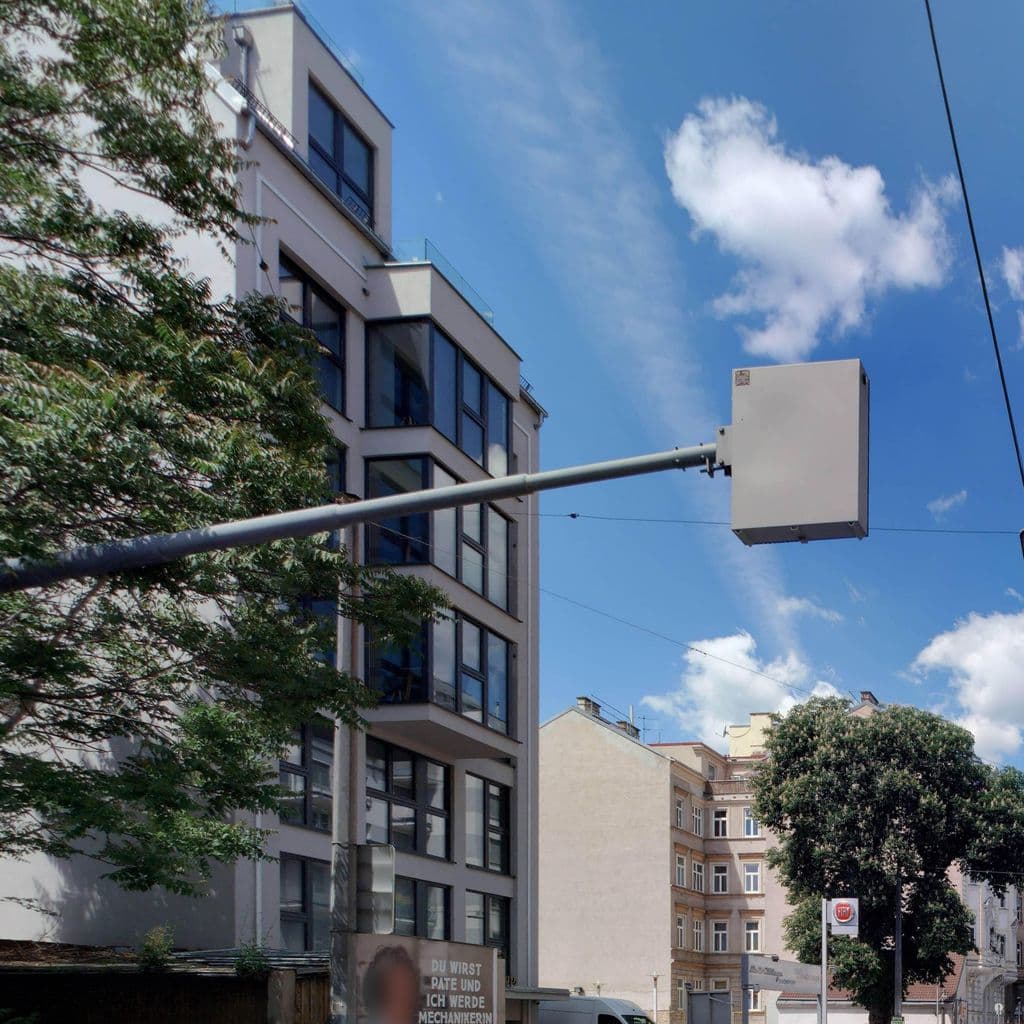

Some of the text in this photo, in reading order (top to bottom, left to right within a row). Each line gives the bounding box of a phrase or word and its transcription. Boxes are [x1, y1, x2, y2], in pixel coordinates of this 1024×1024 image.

[431, 959, 482, 976] DU WIRST
[431, 976, 481, 992] PATE UND
[426, 993, 485, 1009] ICH WERDE
[418, 1010, 493, 1024] MECHANIKERIN
